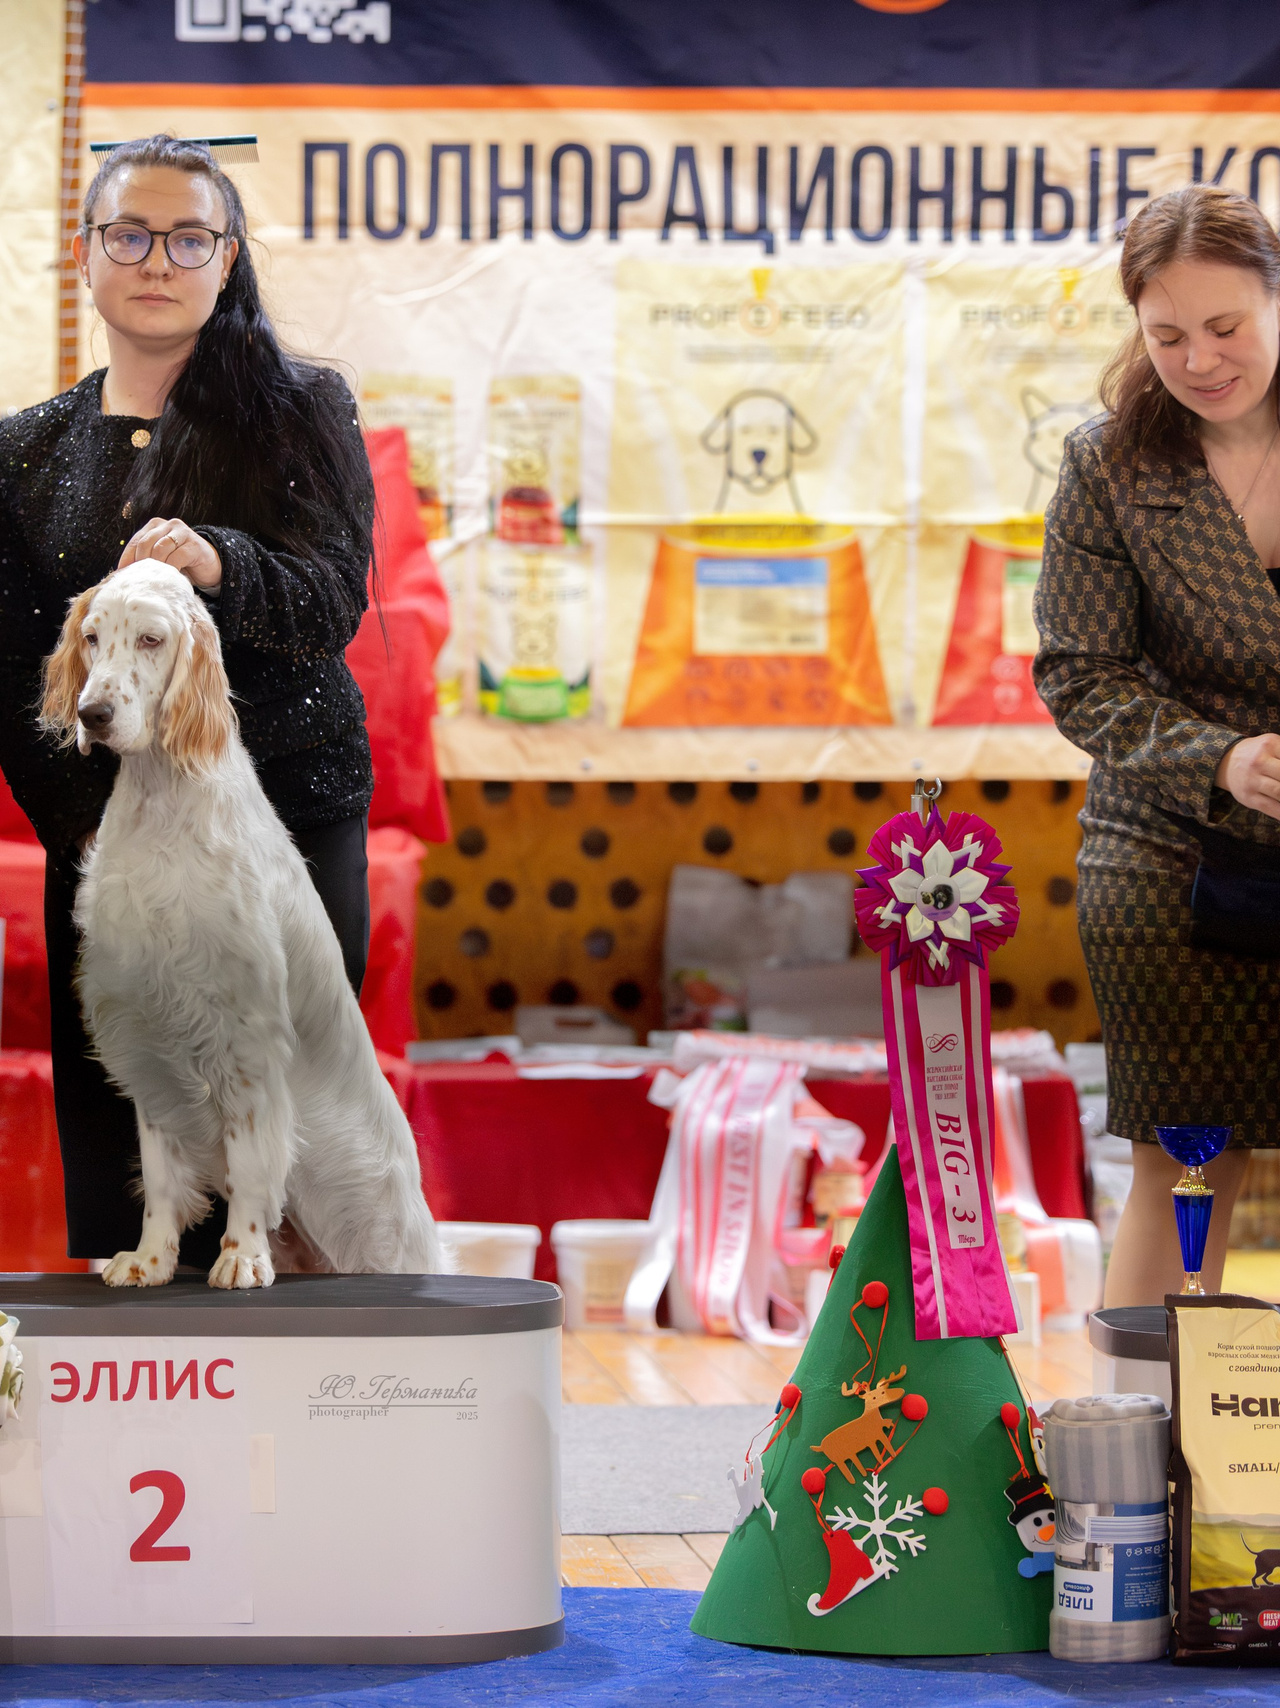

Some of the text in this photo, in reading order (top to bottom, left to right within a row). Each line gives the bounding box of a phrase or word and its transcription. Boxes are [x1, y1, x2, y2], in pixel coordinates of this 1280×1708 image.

[302, 142, 1157, 255] ПОЛНОРАЦИОННЫЕ
[934, 1110, 970, 1176] BIG
[953, 1206, 976, 1223] 3
[958, 1234, 976, 1246] Тверь
[1217, 1343, 1234, 1351] Корм
[1235, 1344, 1254, 1352] сухой
[50, 1358, 235, 1403] ЭЛЛИС
[129, 1469, 191, 1562] 2
[1058, 1592, 1093, 1611] ПЛЕД
[1263, 1619, 1279, 1627] MEAT
